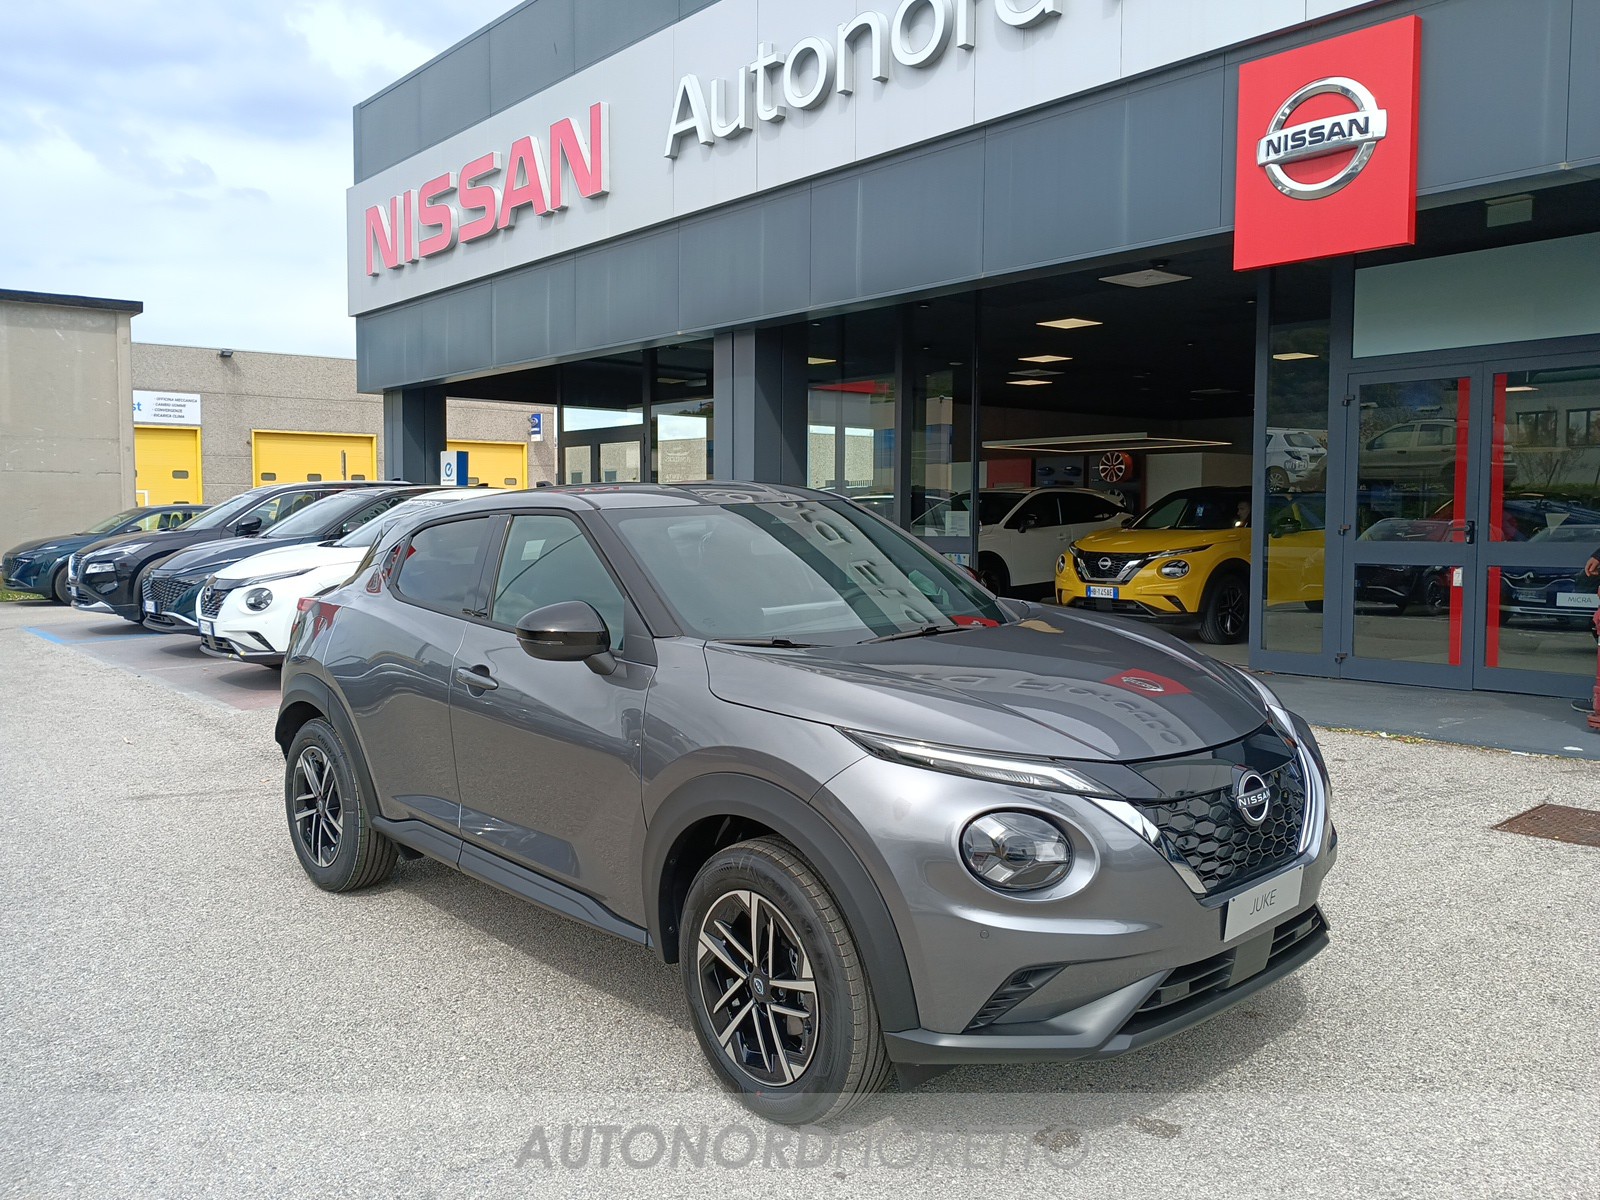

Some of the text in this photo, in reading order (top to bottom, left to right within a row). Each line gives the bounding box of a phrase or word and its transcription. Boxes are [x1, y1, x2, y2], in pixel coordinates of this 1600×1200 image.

[1266, 116, 1370, 157] NISSAN
[365, 102, 609, 277] NISSAN
[1567, 596, 1592, 604] MICRA
[1238, 789, 1271, 808] NISSAN
[1250, 889, 1278, 915] JUKE
